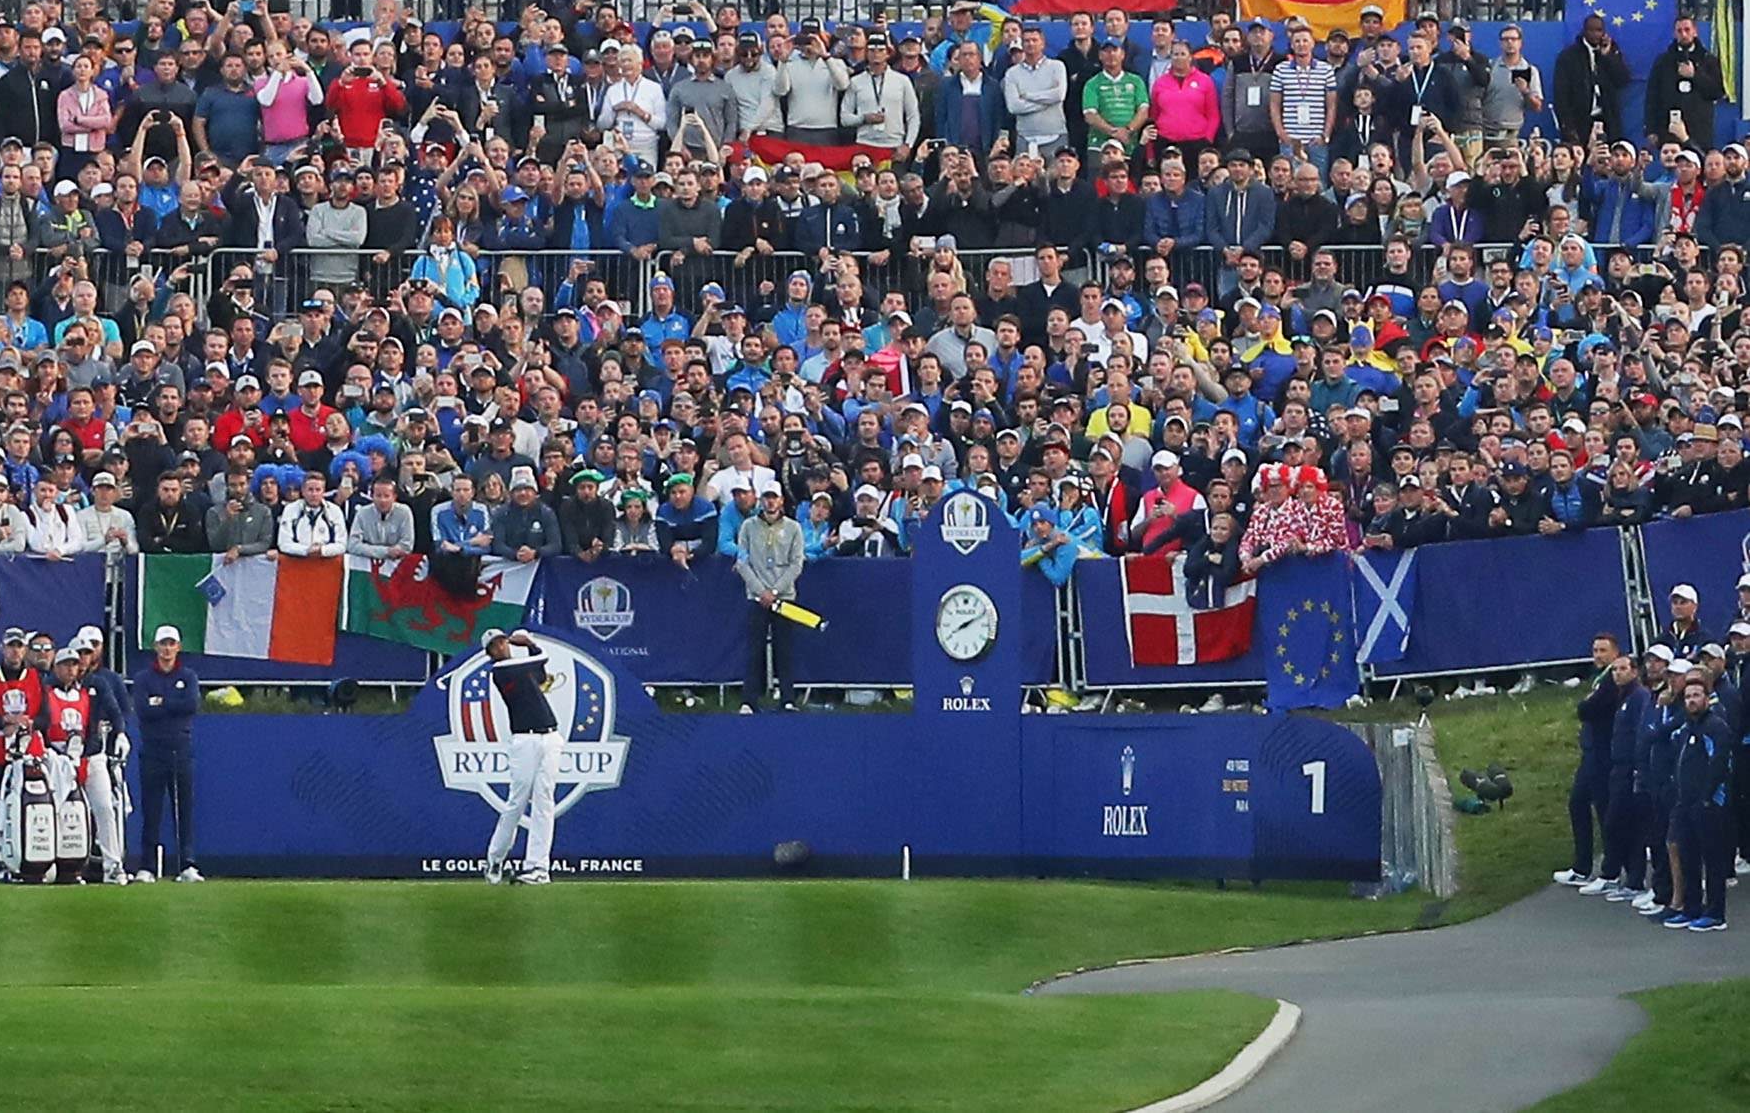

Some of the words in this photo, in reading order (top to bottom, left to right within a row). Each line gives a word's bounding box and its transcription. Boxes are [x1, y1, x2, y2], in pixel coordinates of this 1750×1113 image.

[942, 697, 991, 711] ROLEX
[454, 752, 509, 773] RYD
[1302, 760, 1326, 814] 1
[1103, 805, 1148, 837] ROLEX
[422, 860, 441, 871] LE
[446, 860, 488, 871] GOLF
[503, 860, 576, 873] ATAL,
[580, 860, 643, 871] FRANCE
